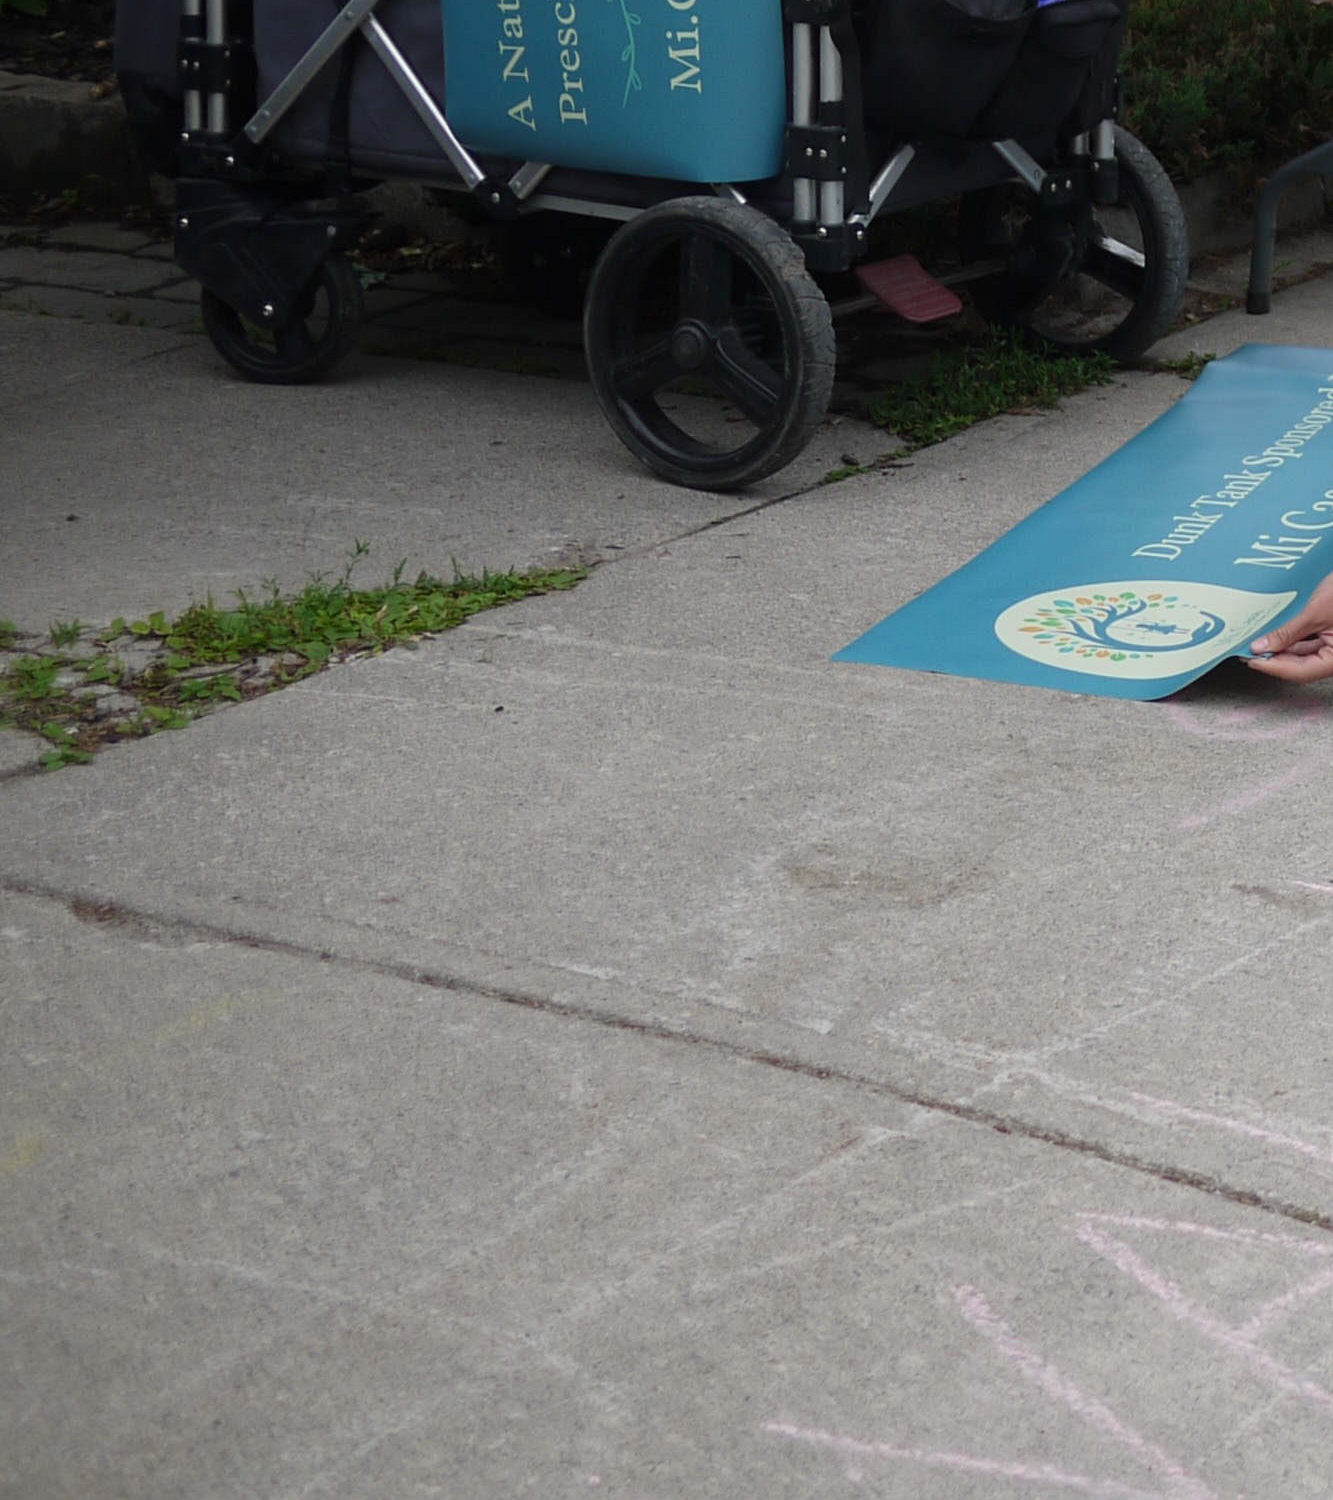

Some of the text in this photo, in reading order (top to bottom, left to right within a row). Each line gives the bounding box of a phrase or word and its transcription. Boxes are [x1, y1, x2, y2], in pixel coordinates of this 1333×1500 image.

[506, 95, 537, 132] A
[1131, 511, 1224, 562] Dunk
[1190, 469, 1272, 509] Tank
[1232, 533, 1323, 571] Mi
